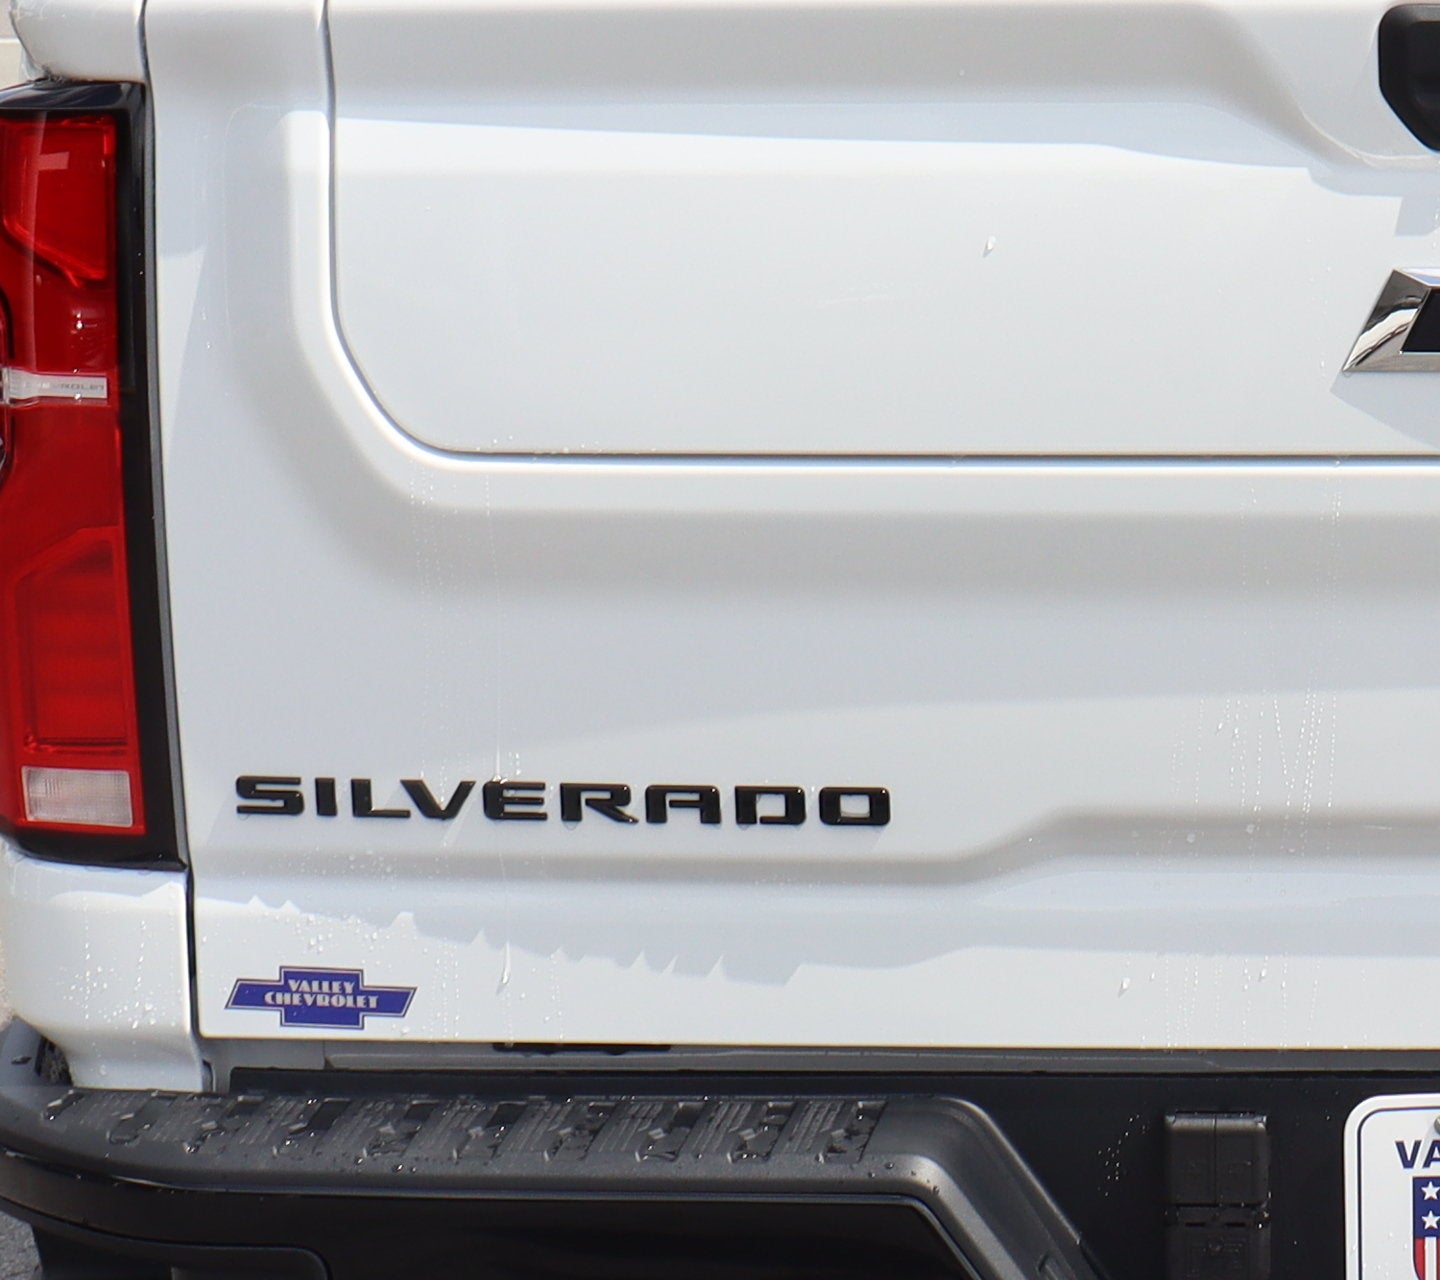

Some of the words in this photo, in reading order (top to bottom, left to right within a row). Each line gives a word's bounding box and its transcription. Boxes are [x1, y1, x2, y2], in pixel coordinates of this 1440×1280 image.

[235, 775, 891, 826] SILVERADO
[287, 979, 355, 995] VALLEY
[263, 991, 379, 1009] CHEVROLET
